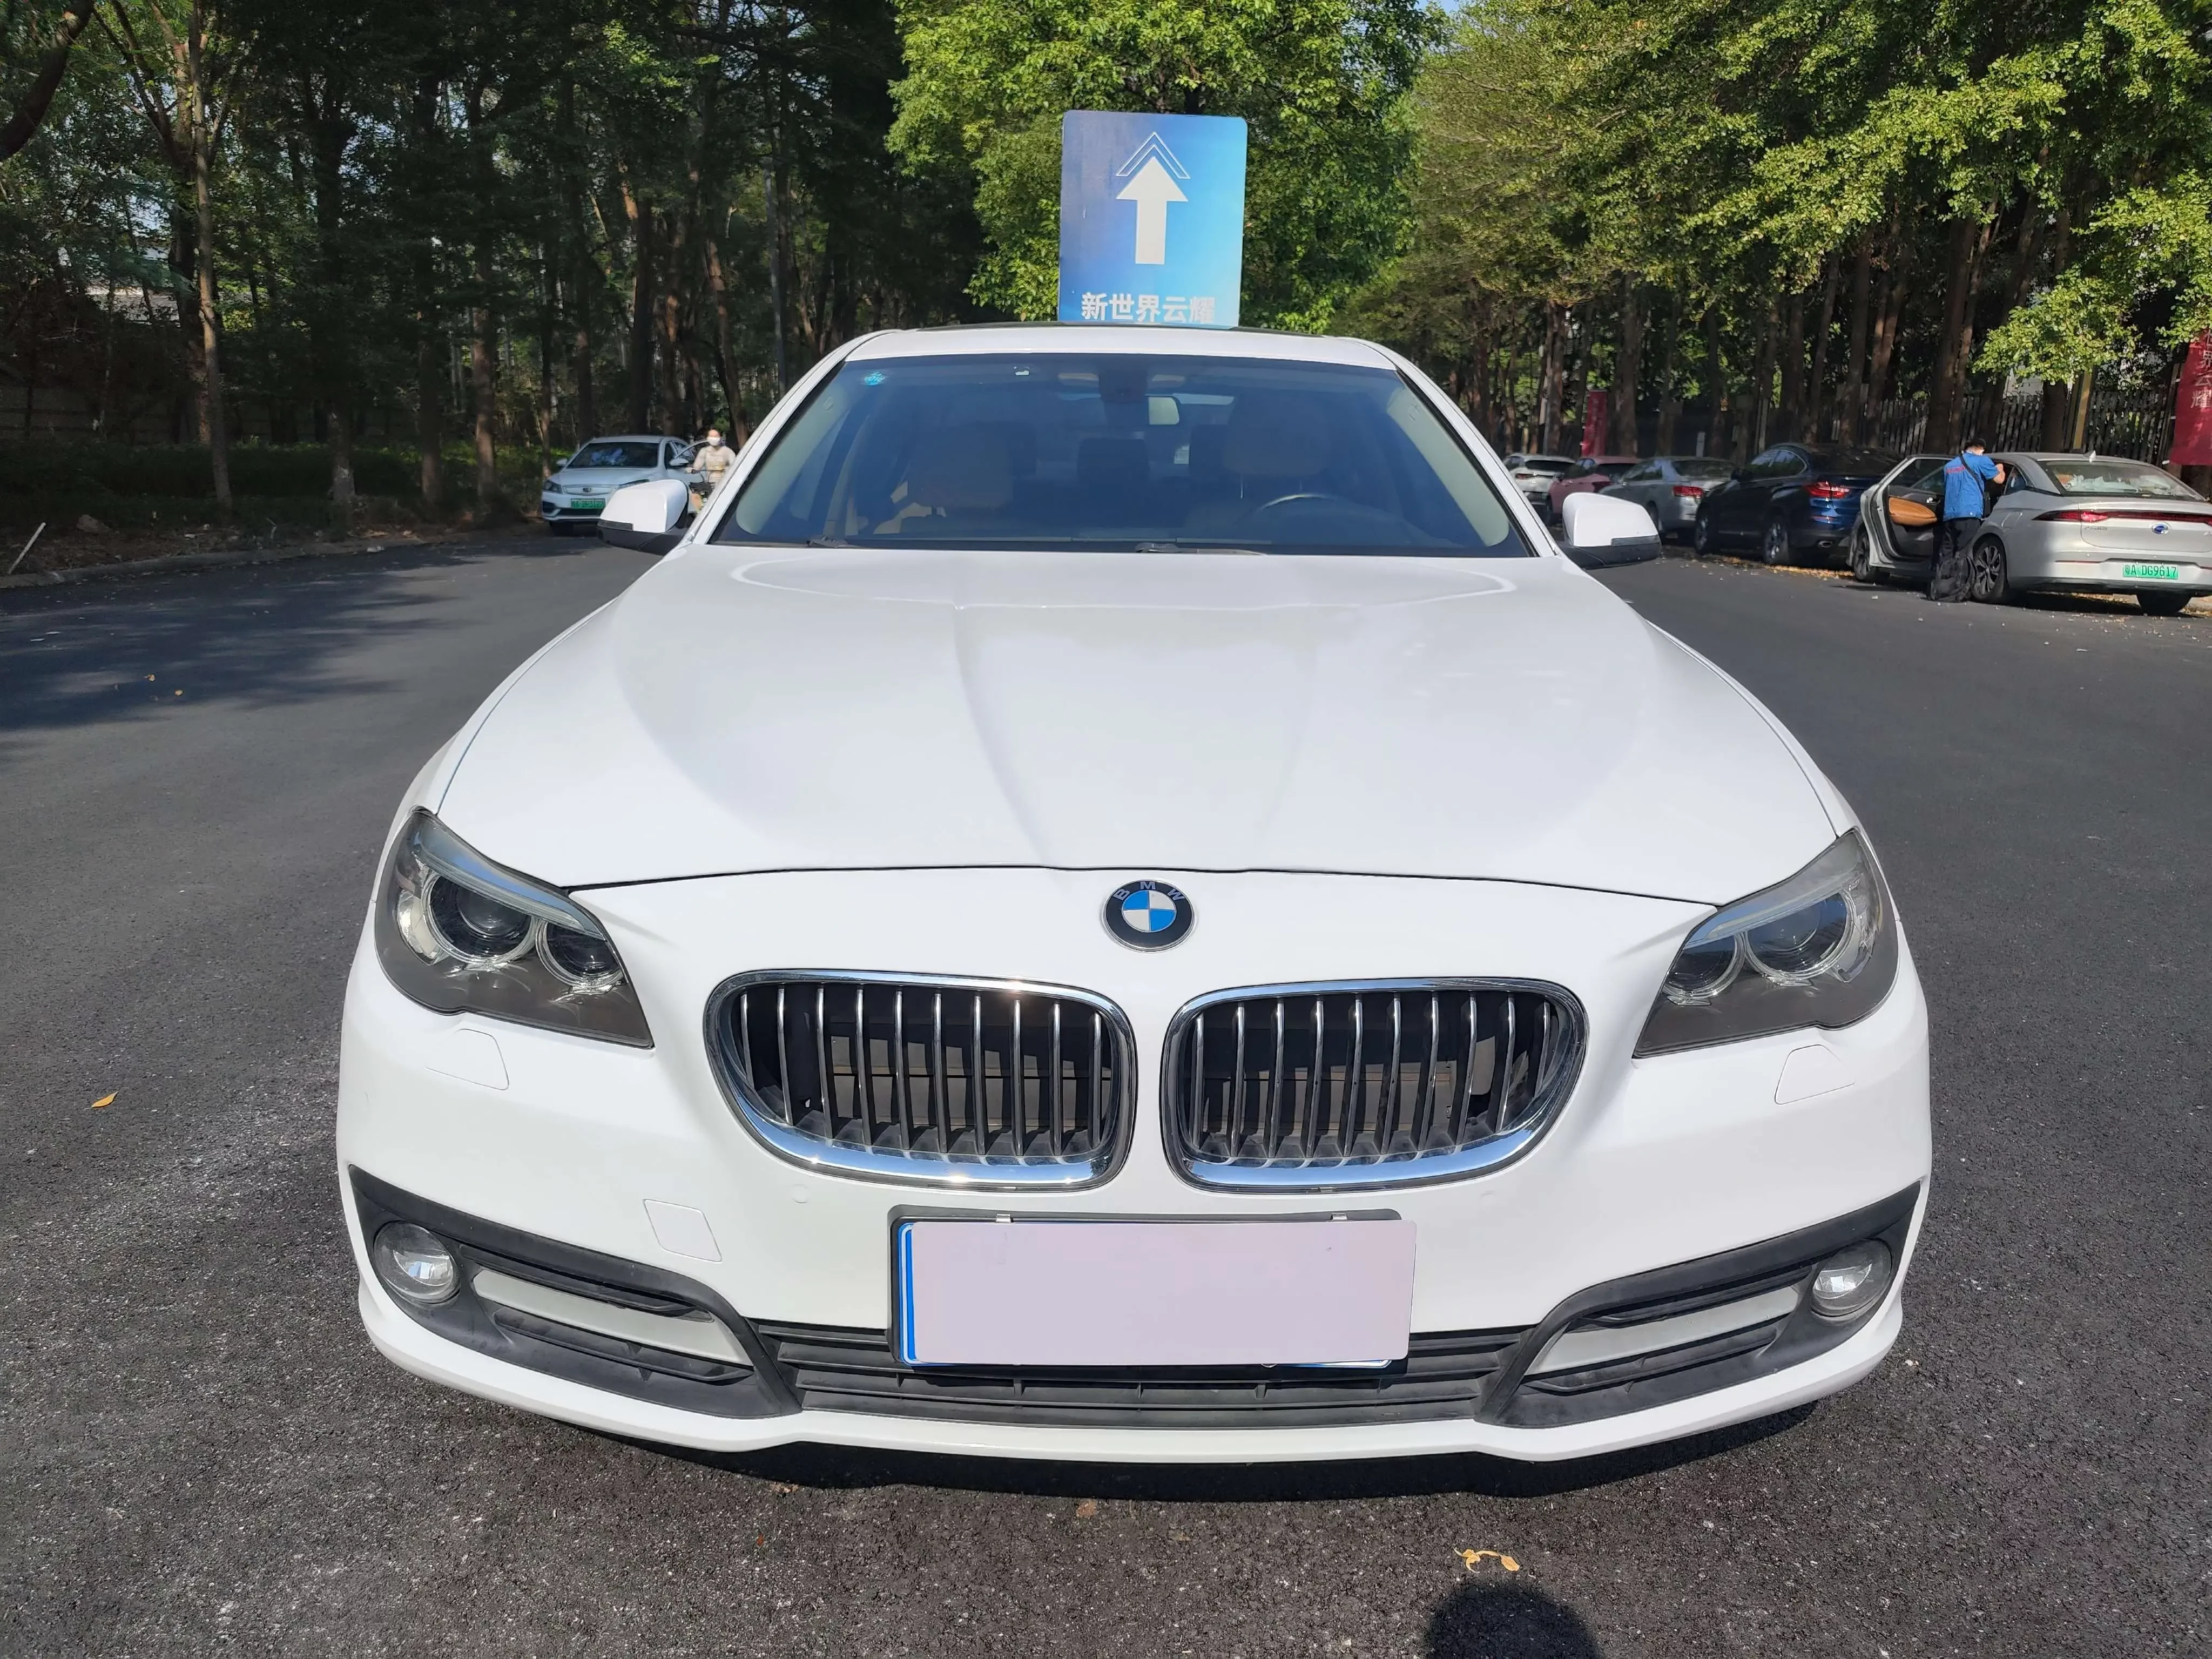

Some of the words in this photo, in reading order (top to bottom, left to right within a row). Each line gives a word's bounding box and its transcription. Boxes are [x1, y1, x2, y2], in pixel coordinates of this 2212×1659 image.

[1081, 292, 1215, 323] 新世界云耀
[2142, 565, 2177, 577] DG9617
[1112, 881, 1185, 901] BMW
